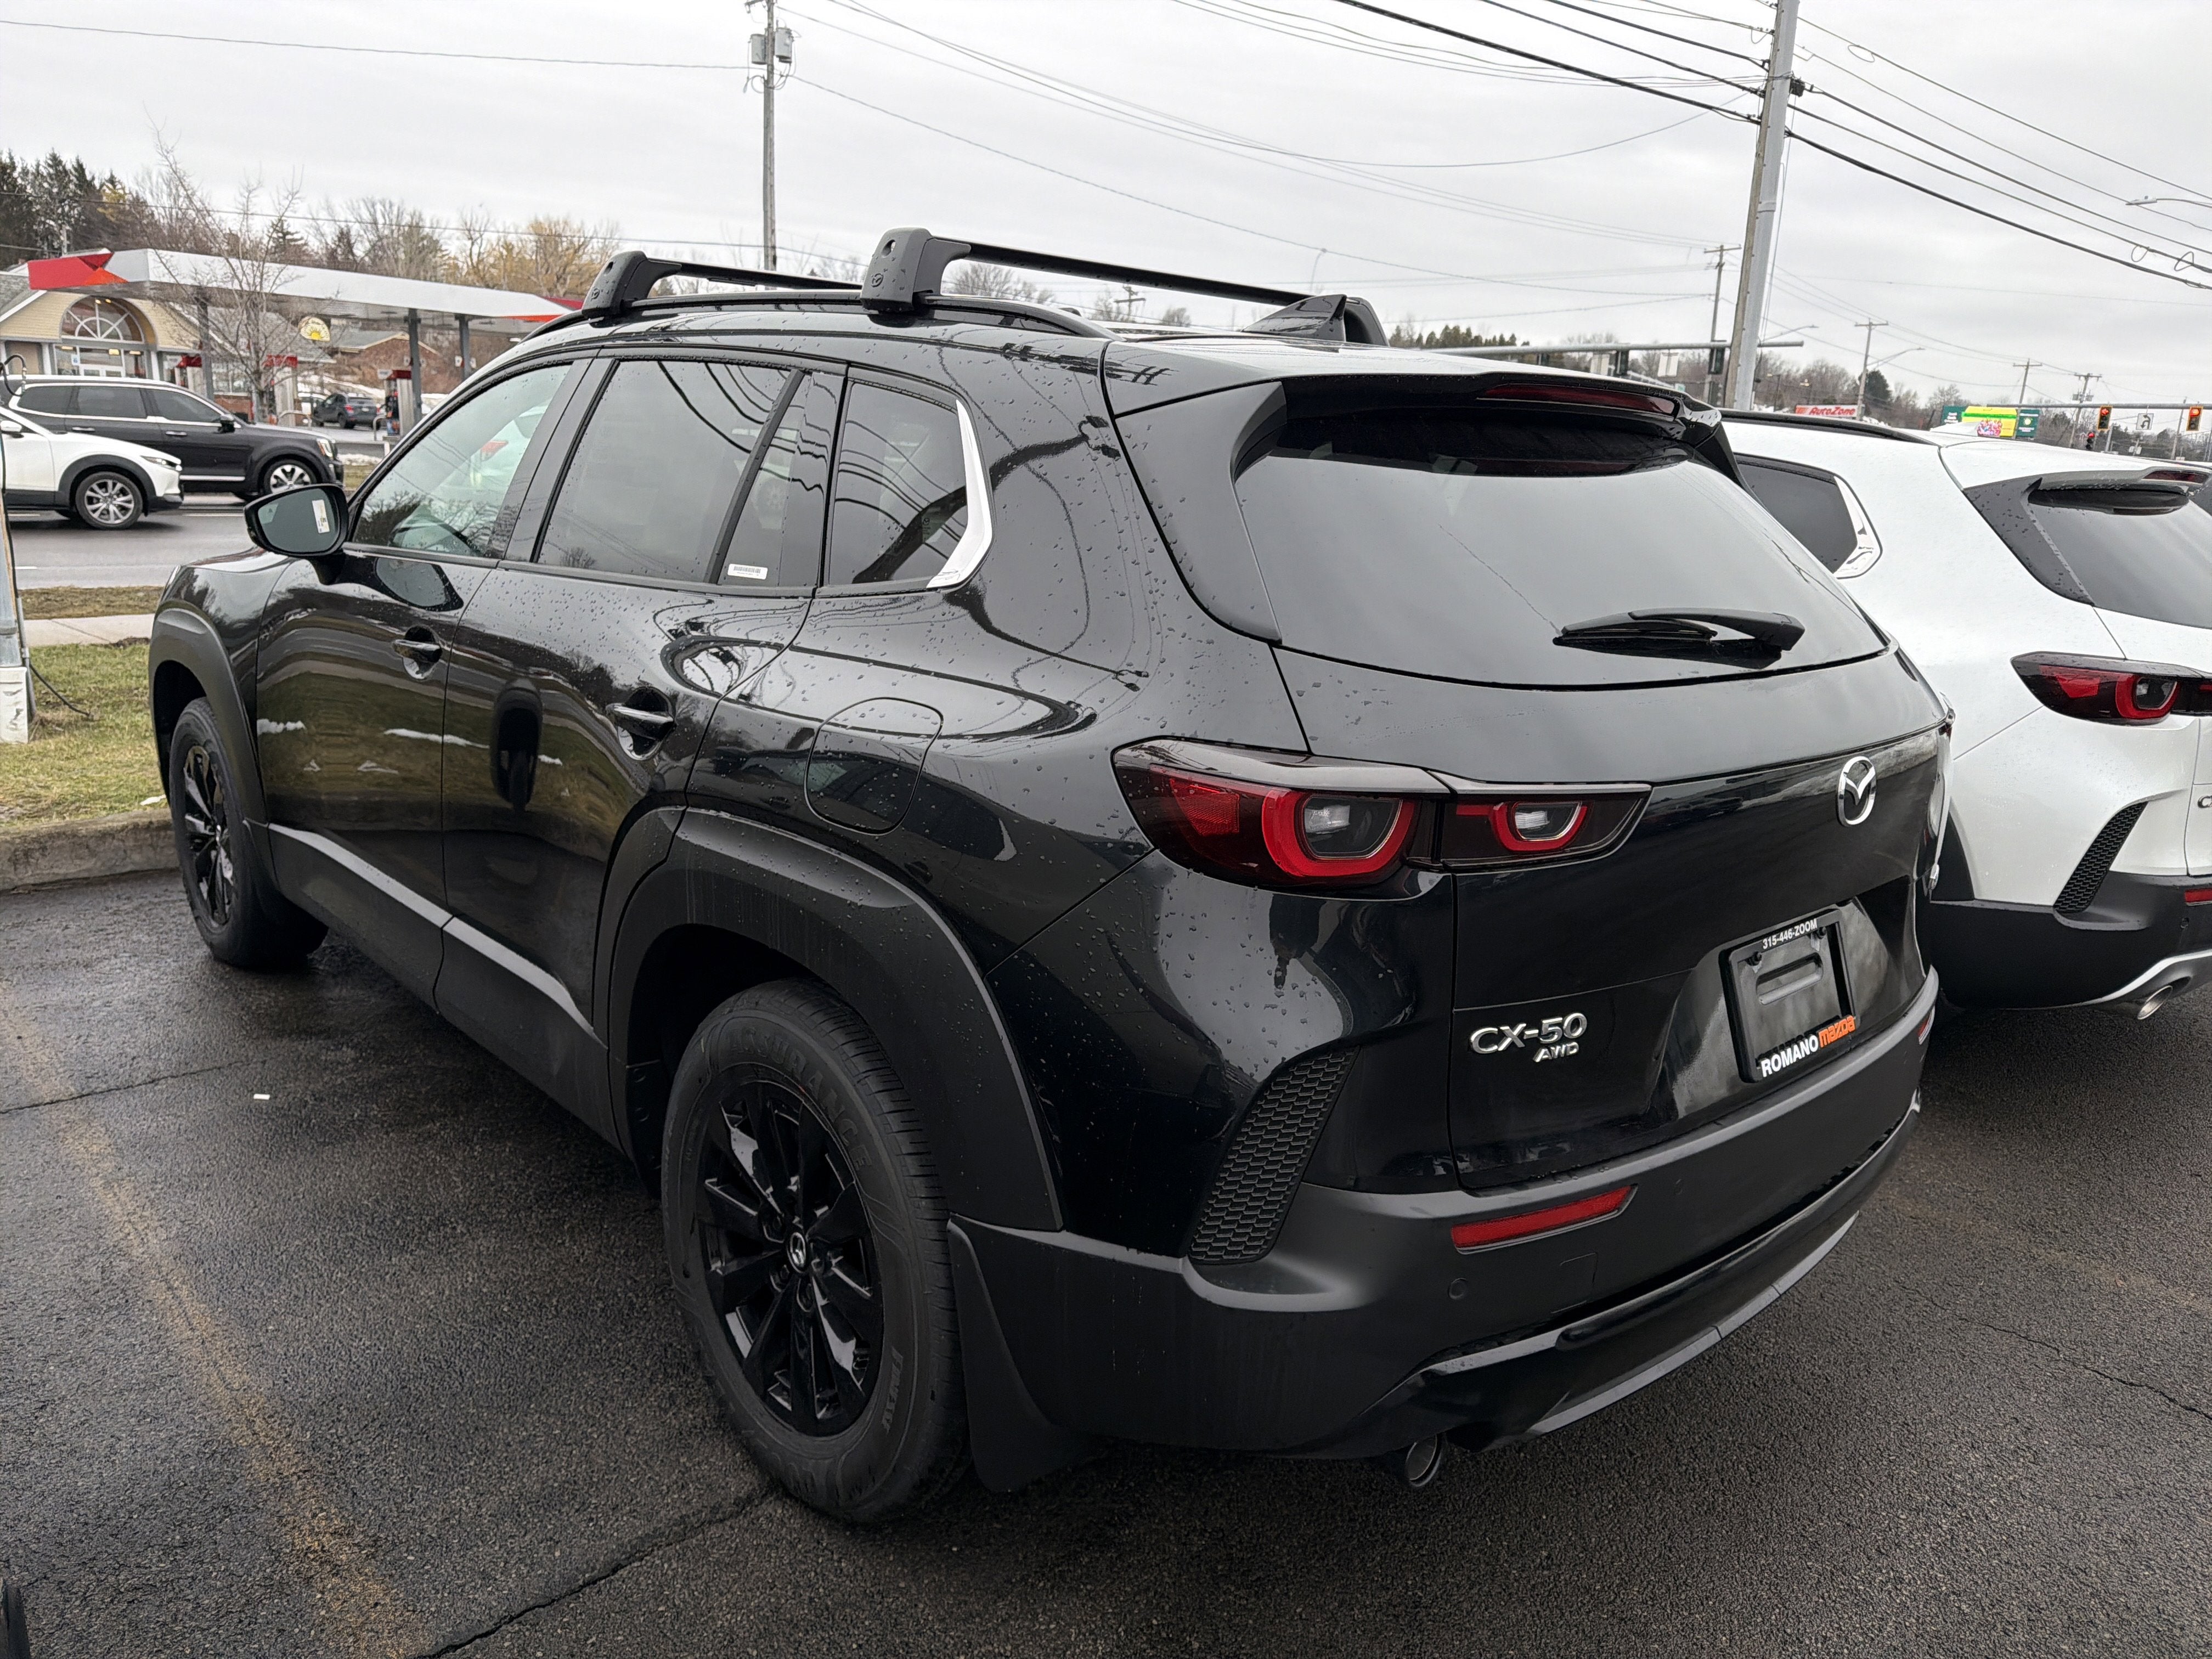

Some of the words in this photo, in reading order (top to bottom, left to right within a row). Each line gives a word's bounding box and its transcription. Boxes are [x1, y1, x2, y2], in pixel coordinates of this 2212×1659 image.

[1809, 407, 1856, 415] AutoZone
[1763, 918, 1818, 949] 315-446-ZOOM
[1469, 1013, 1588, 1054] CX-50
[1533, 1042, 1579, 1063] AWD
[1760, 1034, 1819, 1077] ROMANO
